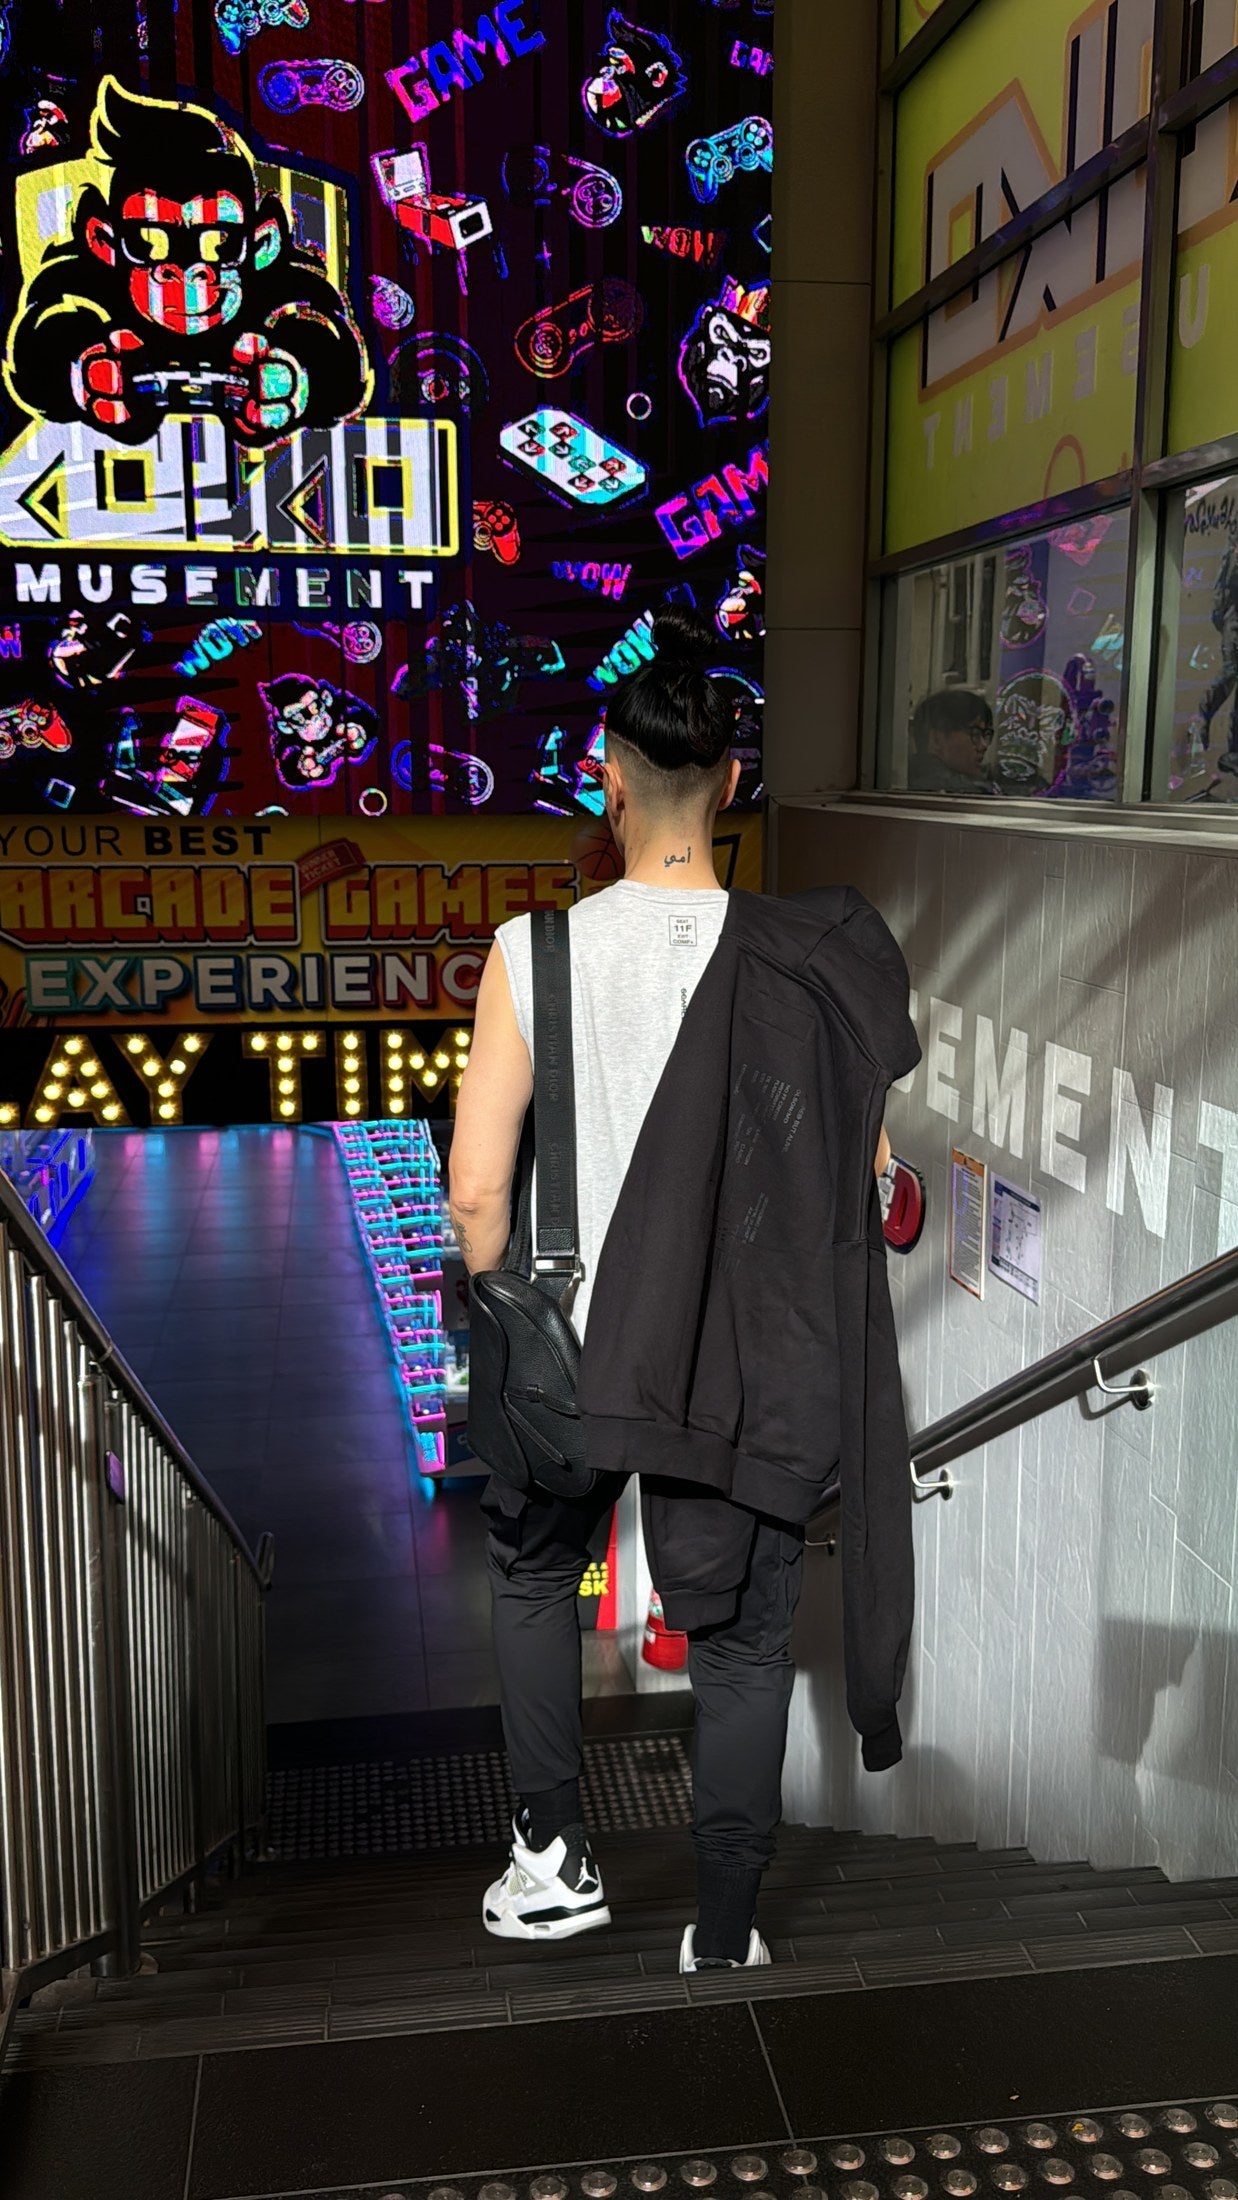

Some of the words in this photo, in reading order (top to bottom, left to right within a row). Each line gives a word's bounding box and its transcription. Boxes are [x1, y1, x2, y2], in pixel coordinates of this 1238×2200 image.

[384, 0, 546, 123] GAME
[15, 562, 433, 608] MUSEMENT
[0, 826, 123, 856] YOUR
[144, 826, 271, 855] BEST
[0, 866, 297, 943] ARCADE
[322, 865, 577, 941] GAMES
[0, 1033, 214, 1126] AY
[893, 989, 1238, 1258] EMEN
